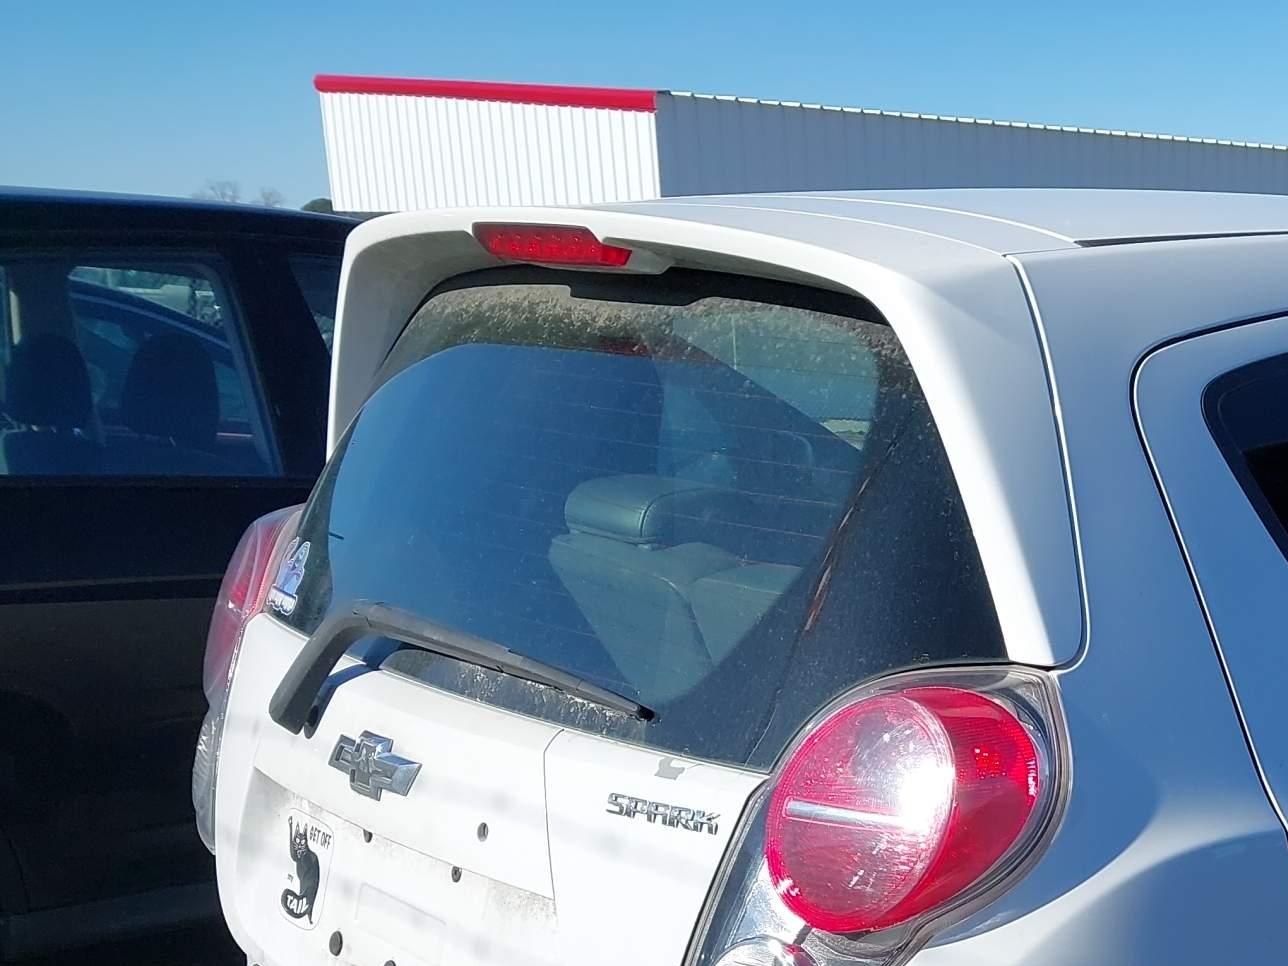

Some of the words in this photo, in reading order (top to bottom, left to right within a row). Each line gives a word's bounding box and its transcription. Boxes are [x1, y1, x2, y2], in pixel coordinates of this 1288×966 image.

[605, 792, 721, 835] SPARK
[309, 826, 321, 844] GET
[321, 831, 332, 849] OFF
[286, 895, 309, 914] TAIL
